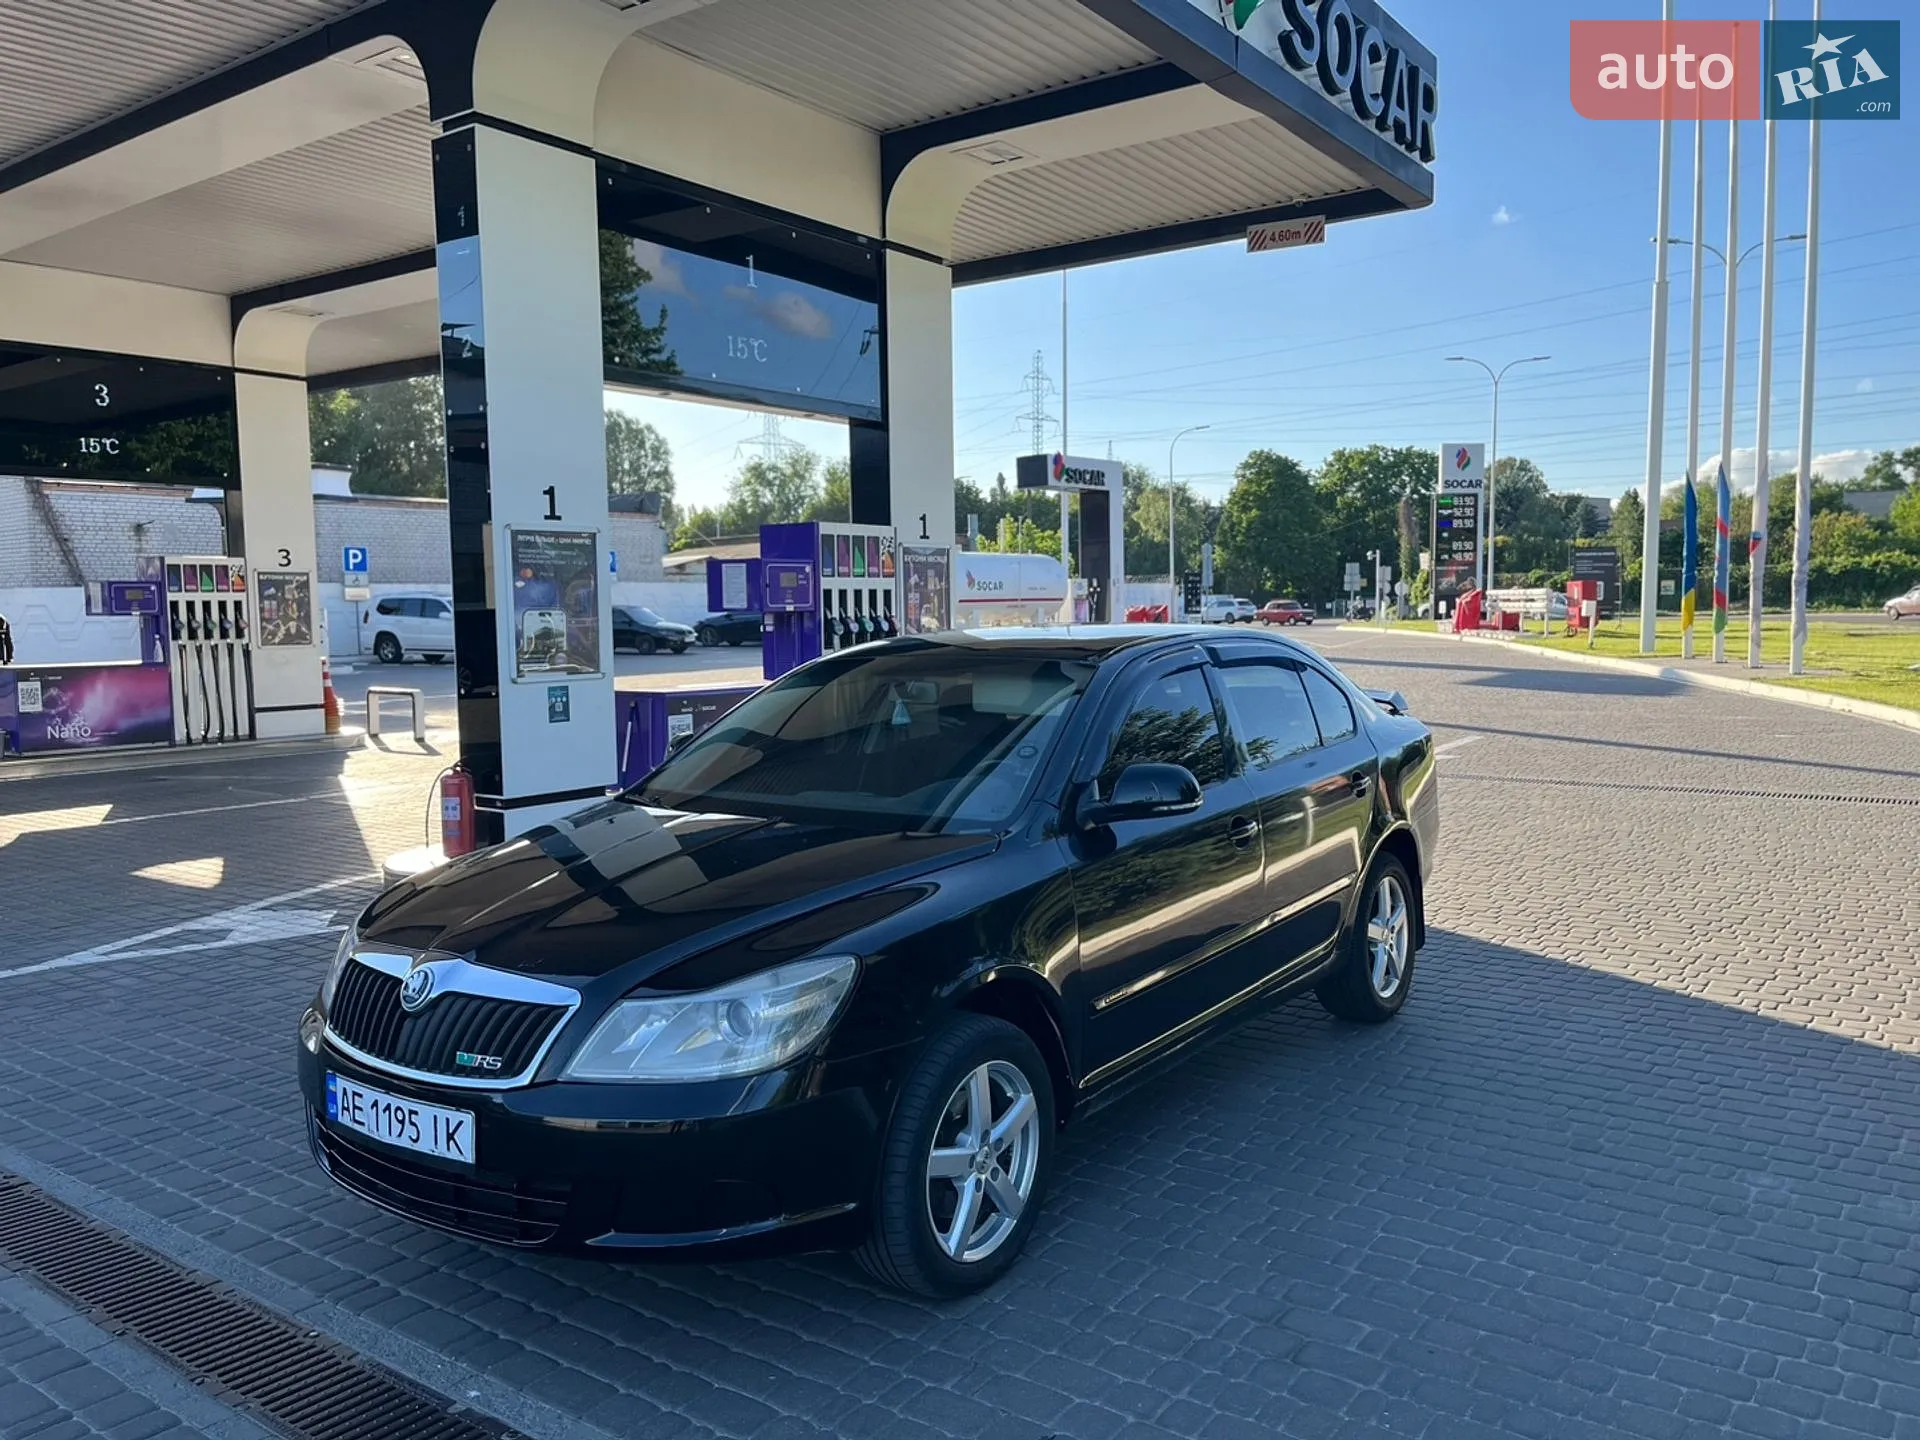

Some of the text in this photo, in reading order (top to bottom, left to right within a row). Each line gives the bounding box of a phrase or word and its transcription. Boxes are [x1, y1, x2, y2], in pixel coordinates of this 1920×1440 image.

[1277, 0, 1437, 163] SOCAR
[745, 254, 758, 288] 1
[95, 383, 110, 407] 3
[1064, 468, 1106, 487] SOCAR
[1444, 479, 1483, 488] SOCAR
[542, 485, 562, 521] 1
[919, 513, 930, 539] 1
[278, 549, 291, 567] 3
[349, 550, 363, 569] P
[976, 581, 1004, 591] SOCAR
[47, 726, 91, 739] Nano
[341, 1087, 464, 1156] AE 1195 IK
